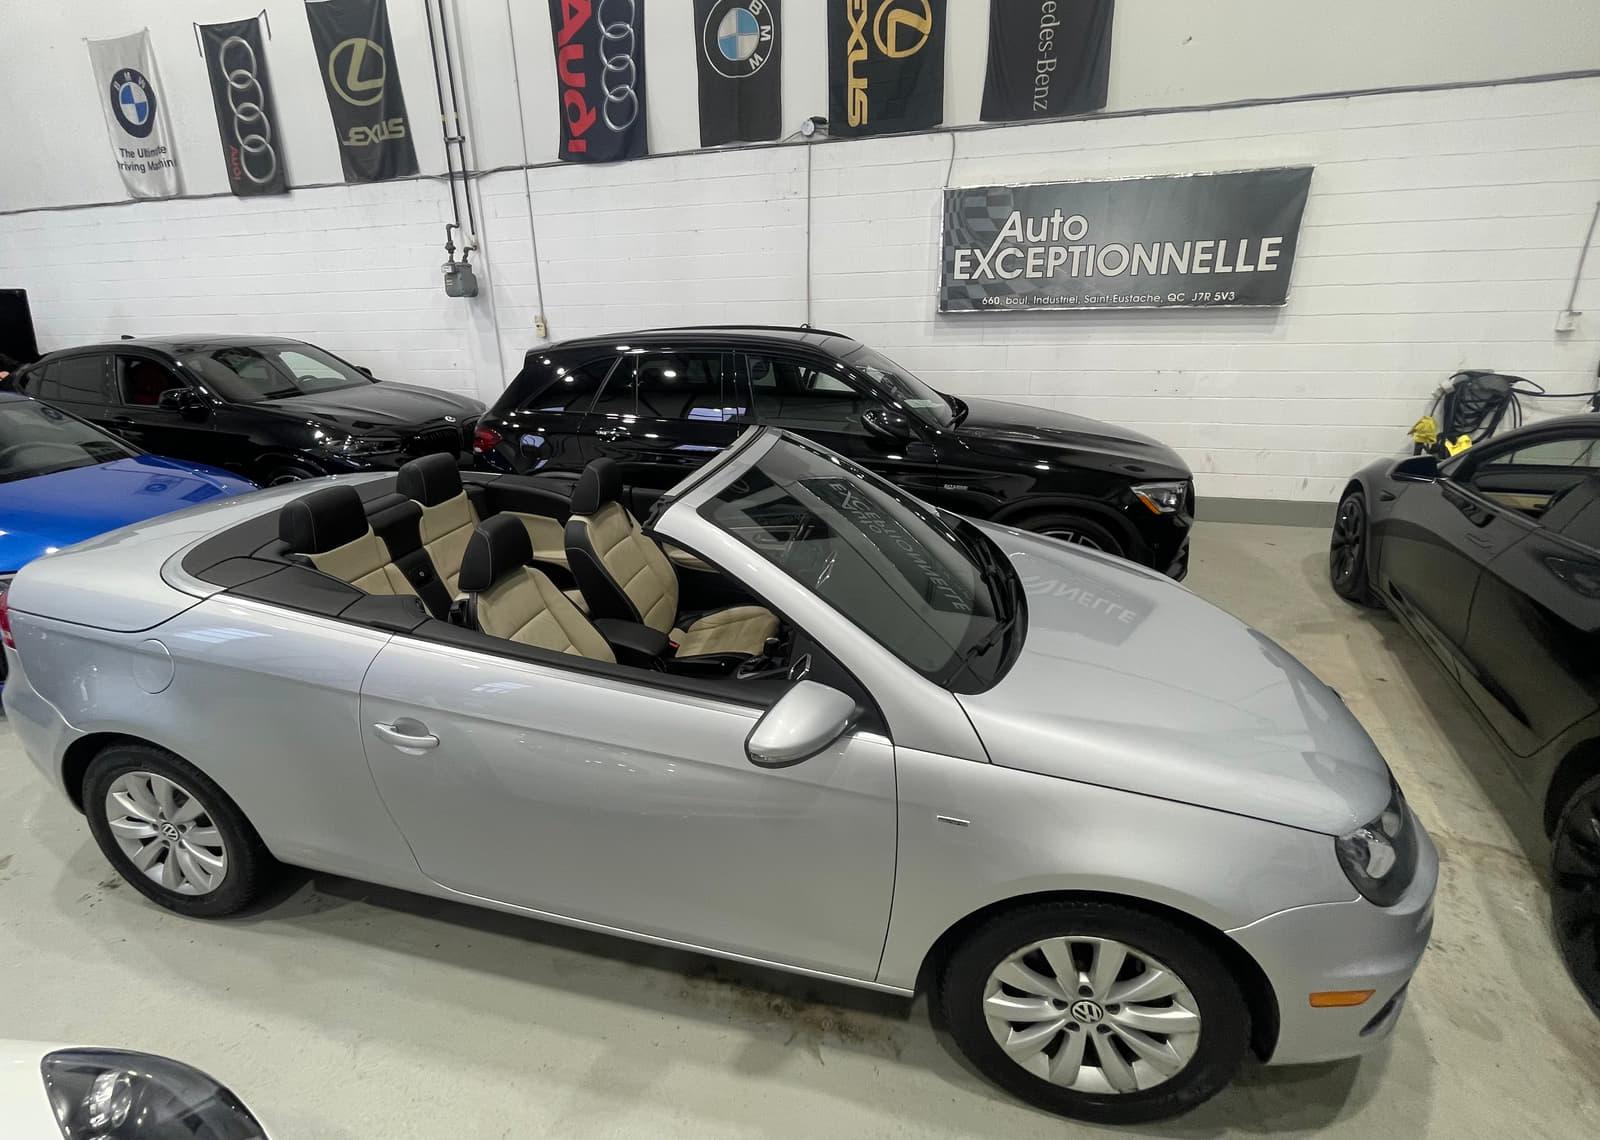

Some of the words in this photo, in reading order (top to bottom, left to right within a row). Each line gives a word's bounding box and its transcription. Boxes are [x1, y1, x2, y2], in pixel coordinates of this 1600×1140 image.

[748, 1, 772, 71] BMW
[119, 147, 135, 159] The
[990, 208, 1089, 243] Auto
[953, 236, 1283, 281] EXCEPTIONNELLE
[1167, 292, 1185, 302] QC
[1191, 292, 1211, 302] J7R
[1213, 291, 1235, 301] 5V3
